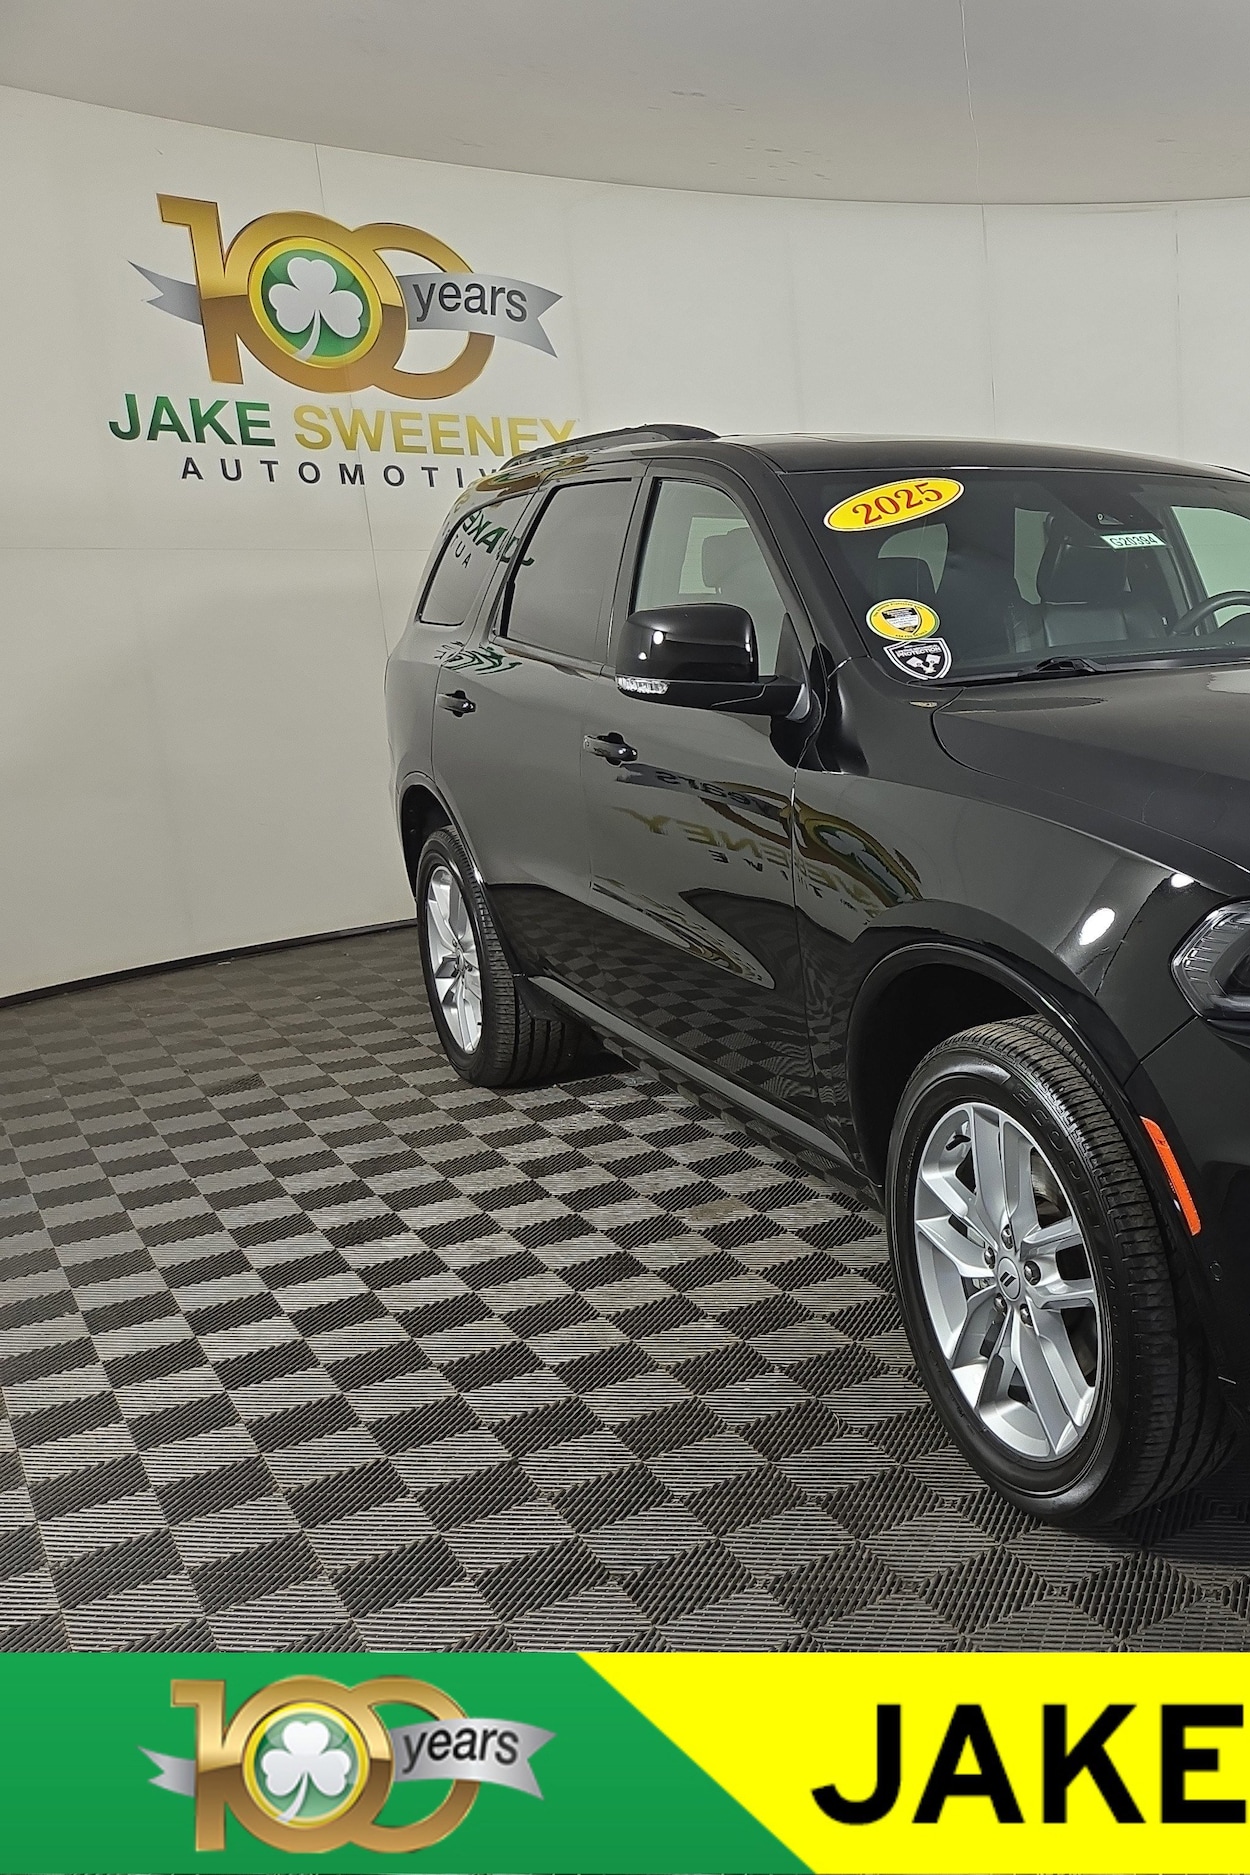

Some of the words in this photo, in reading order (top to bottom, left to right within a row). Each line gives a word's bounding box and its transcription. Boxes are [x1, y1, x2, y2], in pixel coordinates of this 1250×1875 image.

[414, 274, 529, 323] years
[108, 392, 275, 447] JAKE
[852, 482, 943, 525] 2025
